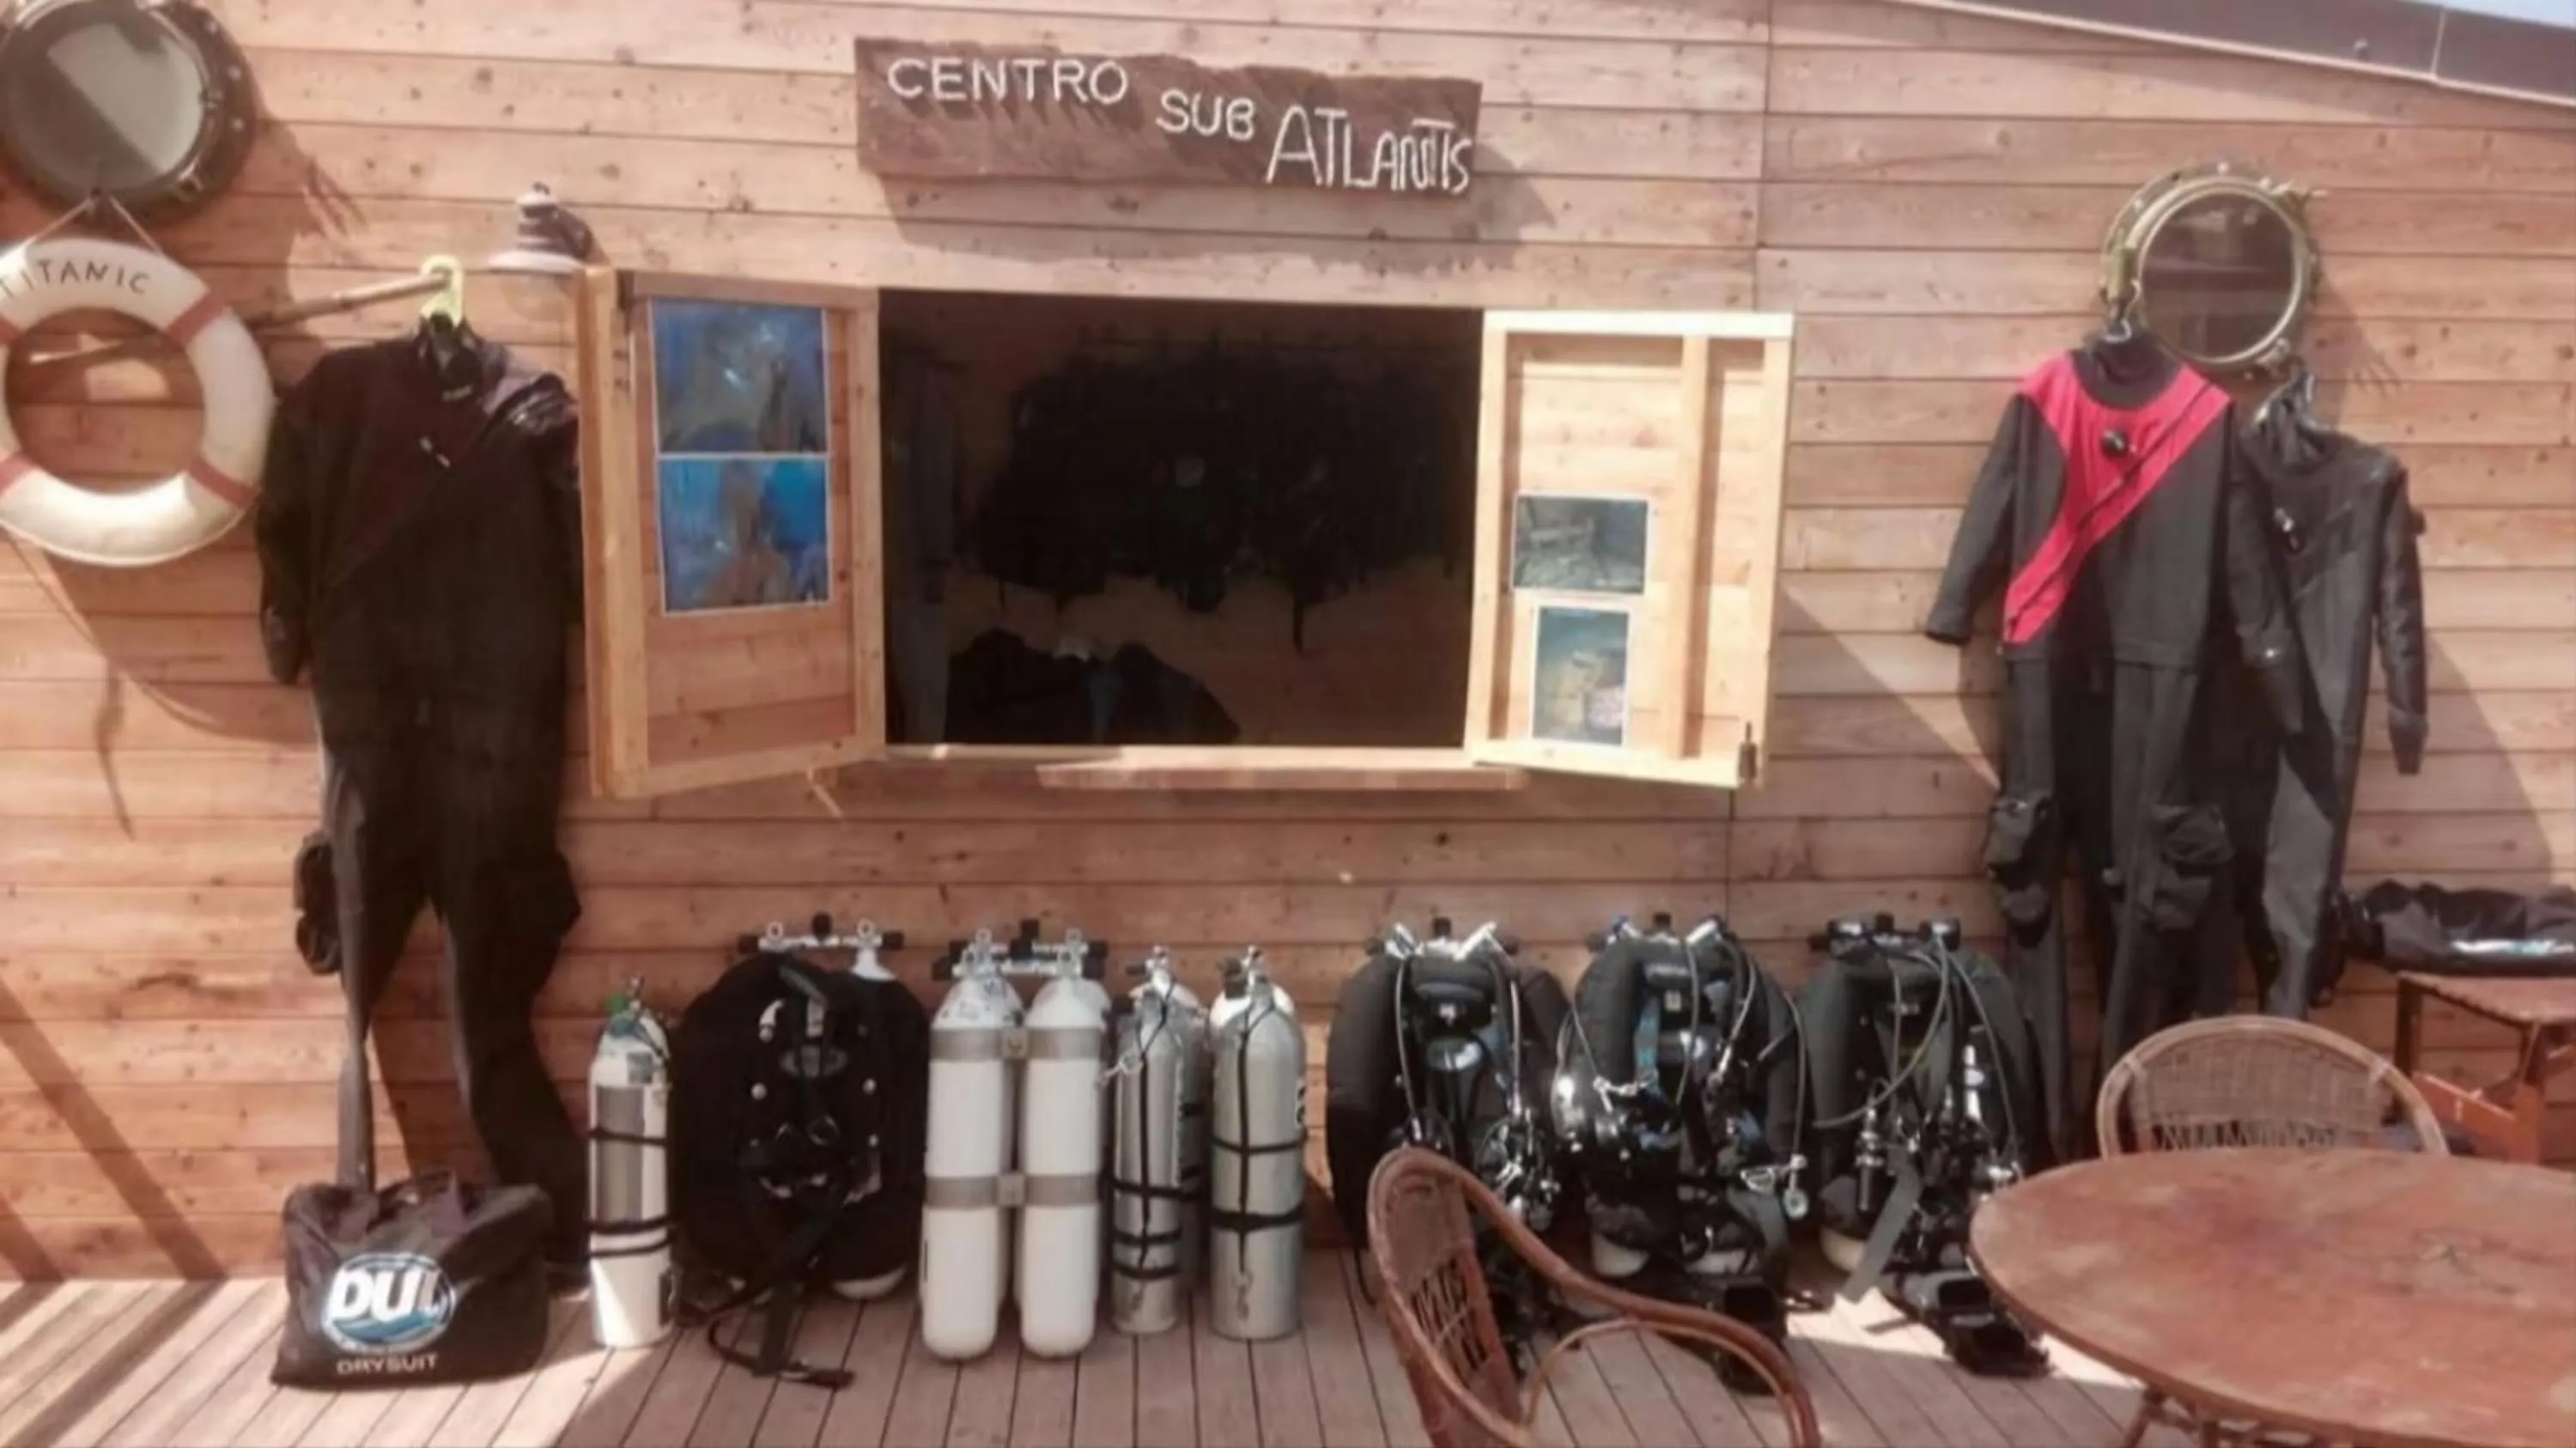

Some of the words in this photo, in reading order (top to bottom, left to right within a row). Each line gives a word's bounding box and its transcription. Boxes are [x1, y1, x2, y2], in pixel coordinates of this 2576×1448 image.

[887, 58, 1130, 105] CENTRO
[1155, 88, 1255, 141] SUB
[1265, 104, 1473, 194] ATLANTIS
[337, 1352, 439, 1374] DRYSUIT
